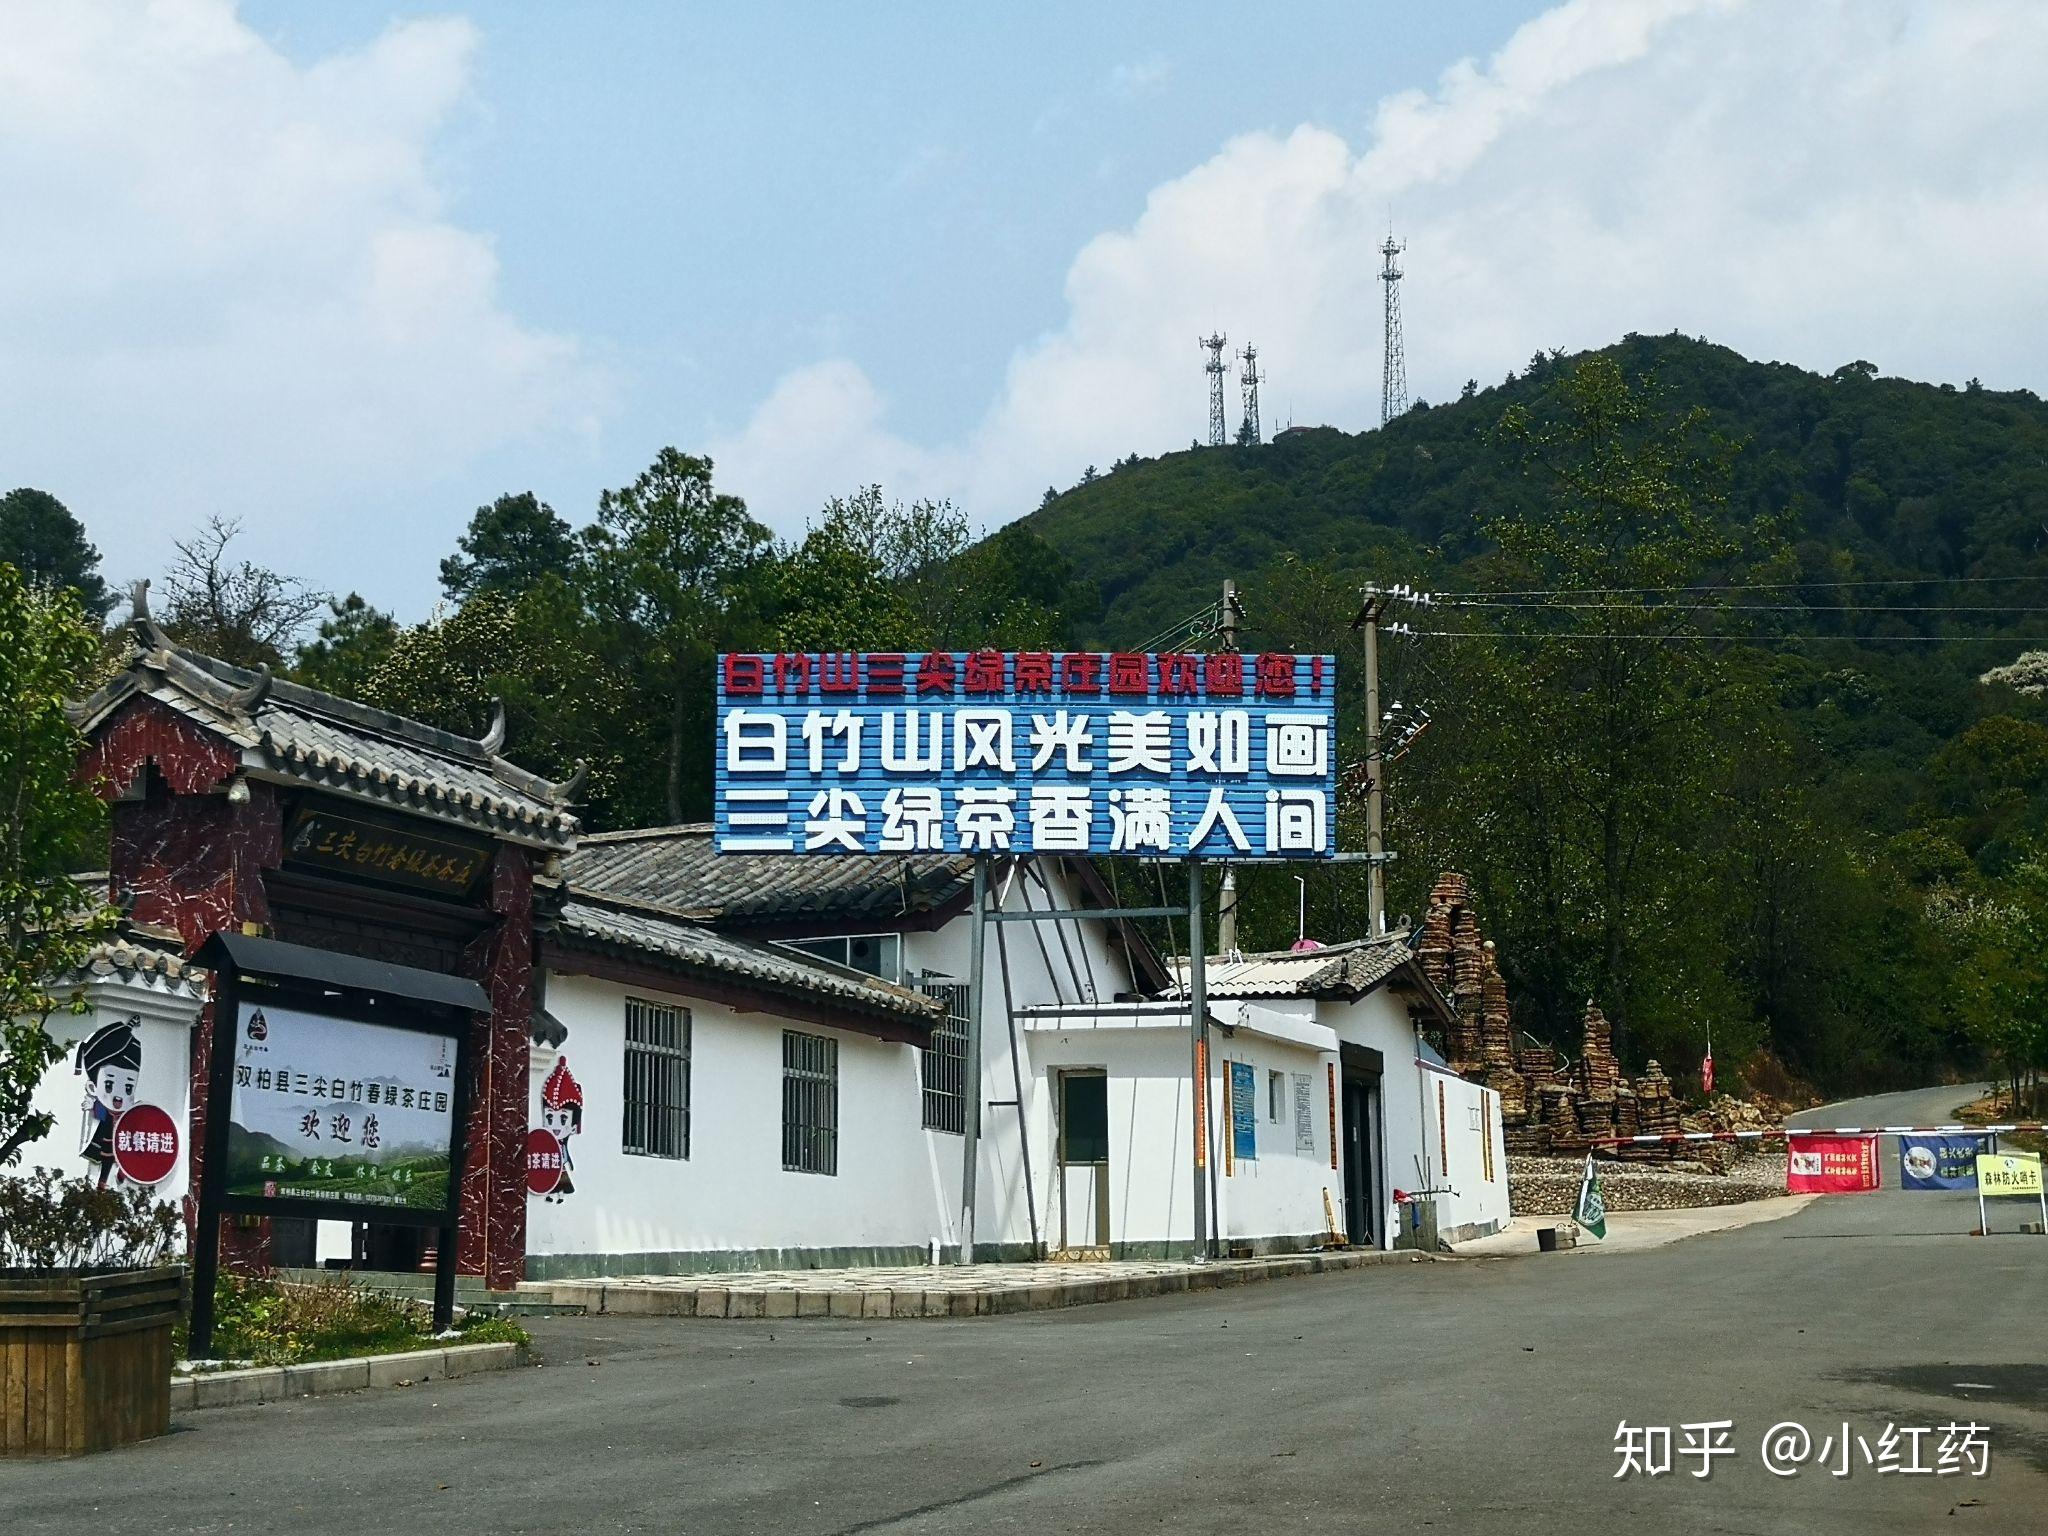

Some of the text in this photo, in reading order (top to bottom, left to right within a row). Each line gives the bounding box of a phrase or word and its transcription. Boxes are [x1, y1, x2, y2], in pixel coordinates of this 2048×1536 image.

[723, 651, 1325, 694] 白竹山三尖绿茶庄园欢迎您！
[723, 708, 1328, 776] 白竹山风光美如画
[720, 786, 1327, 853] 三尖绿茶香满人间
[117, 1131, 174, 1153] 就餐请进
[299, 1109, 381, 1149] 欢迎您
[1985, 1170, 2036, 1186] 森林防火哨卡
